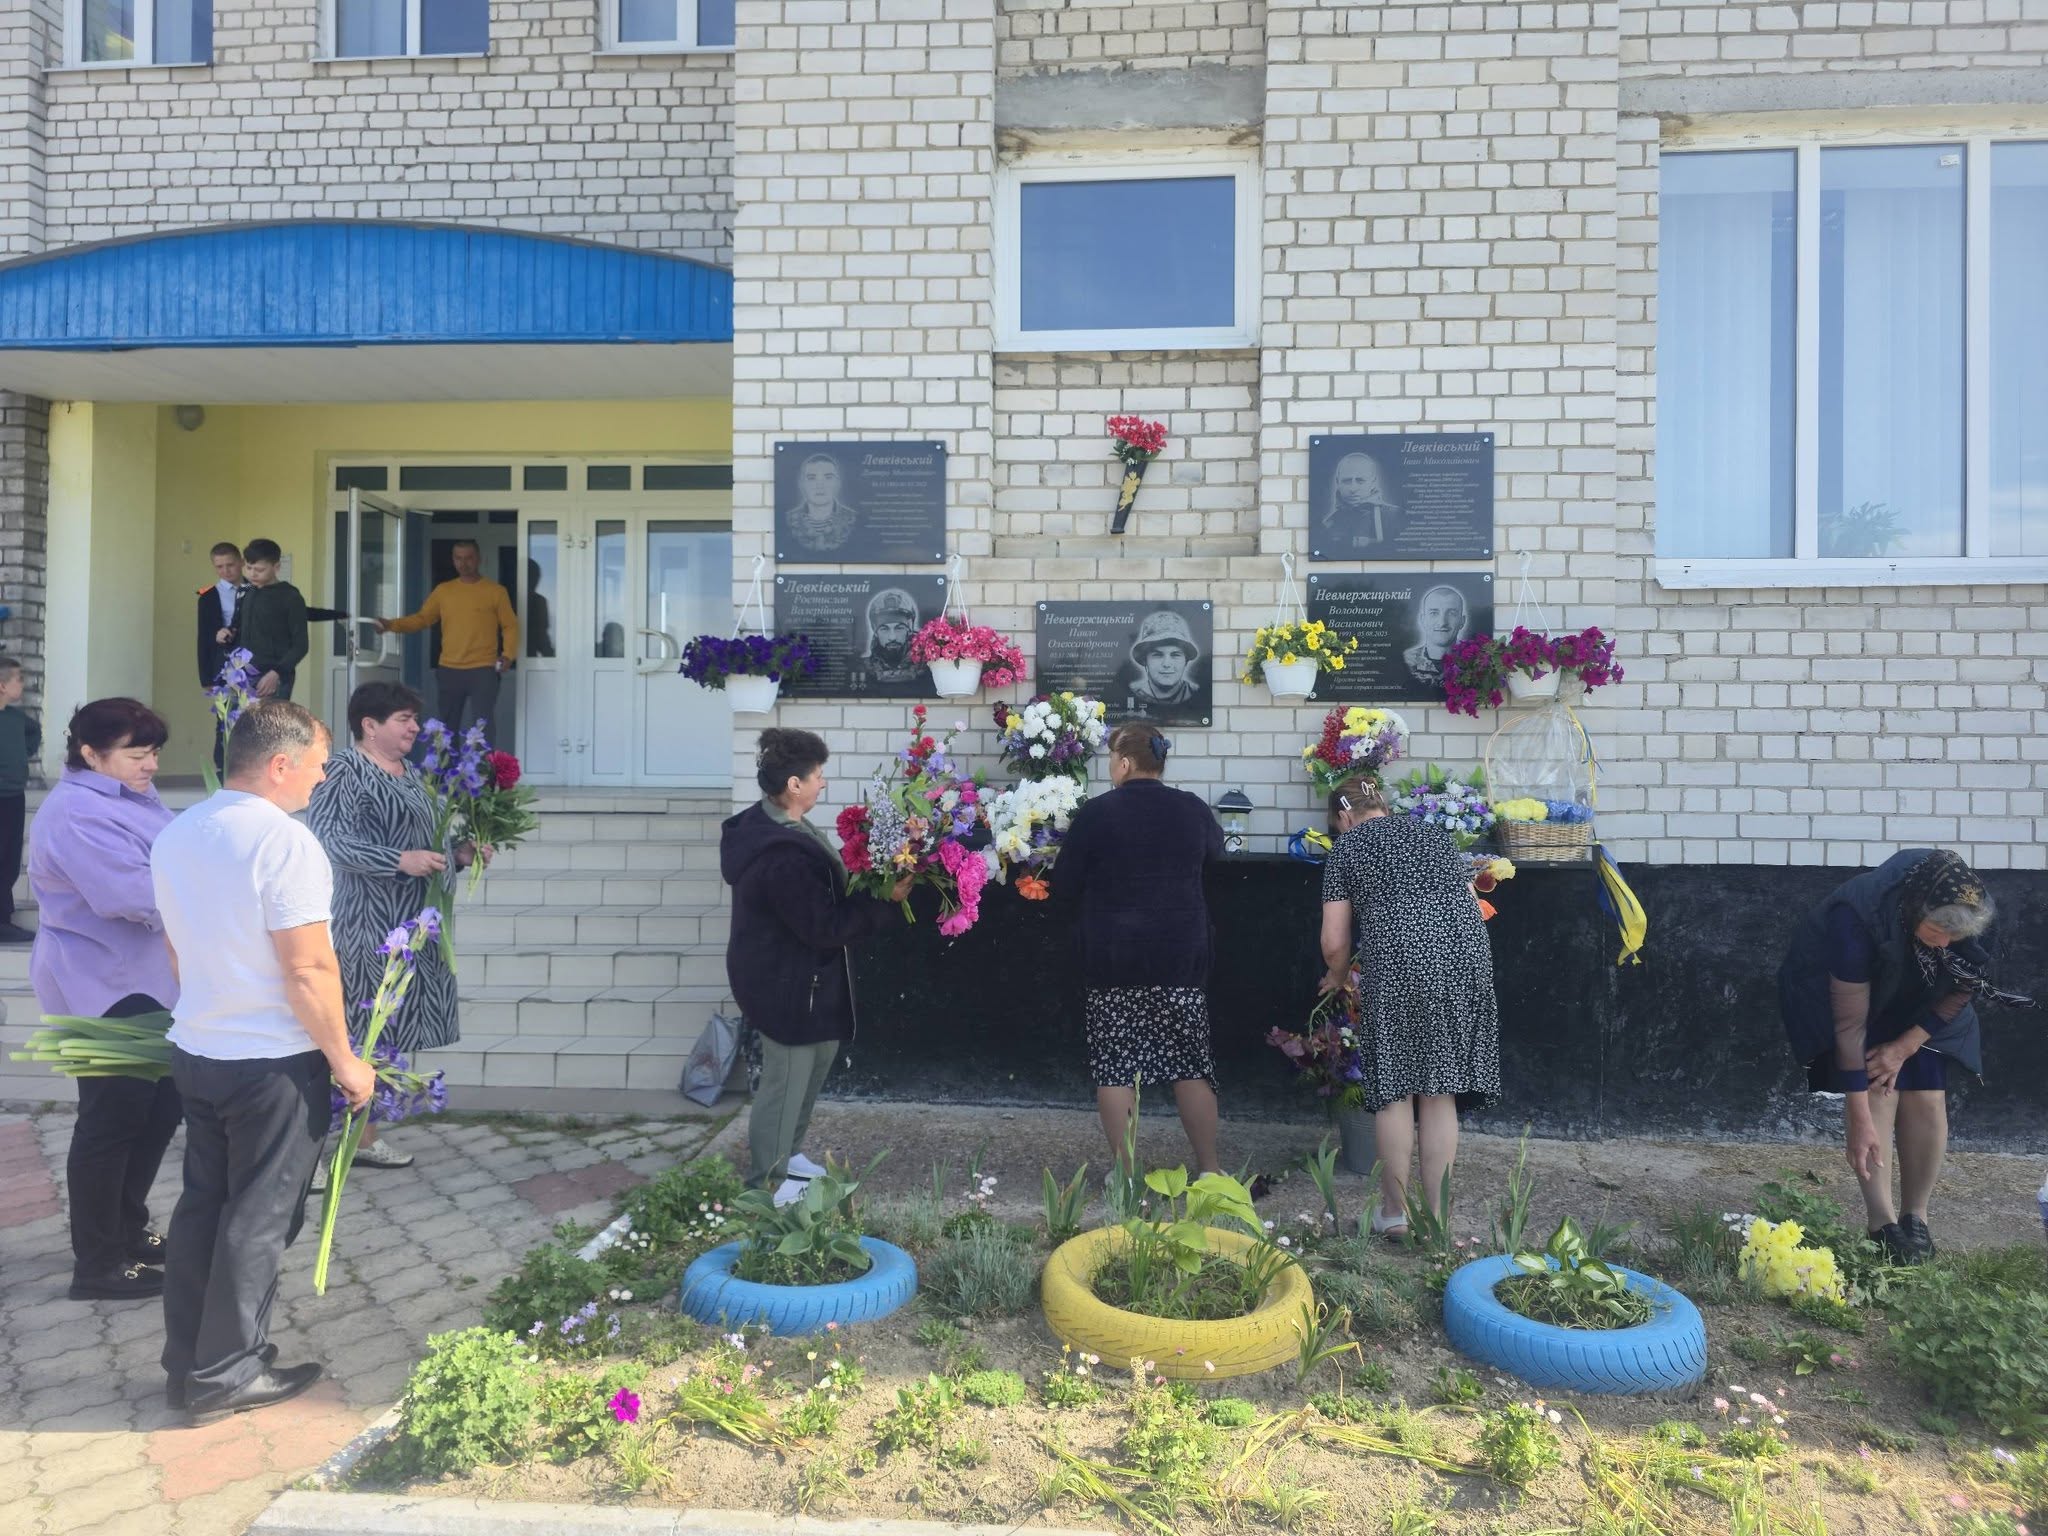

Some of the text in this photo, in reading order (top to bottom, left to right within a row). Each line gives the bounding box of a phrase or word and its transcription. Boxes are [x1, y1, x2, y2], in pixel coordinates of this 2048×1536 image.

[1401, 441, 1481, 453] Левківський
[784, 581, 871, 593] Левківський
[1315, 588, 1411, 603] Невмержицький
[1329, 605, 1383, 616] Володимир
[1044, 613, 1135, 627] Невмержицький
[1328, 620, 1383, 628] Васильович
[1069, 628, 1098, 637] Павло
[1048, 640, 1119, 649] Олександрович
